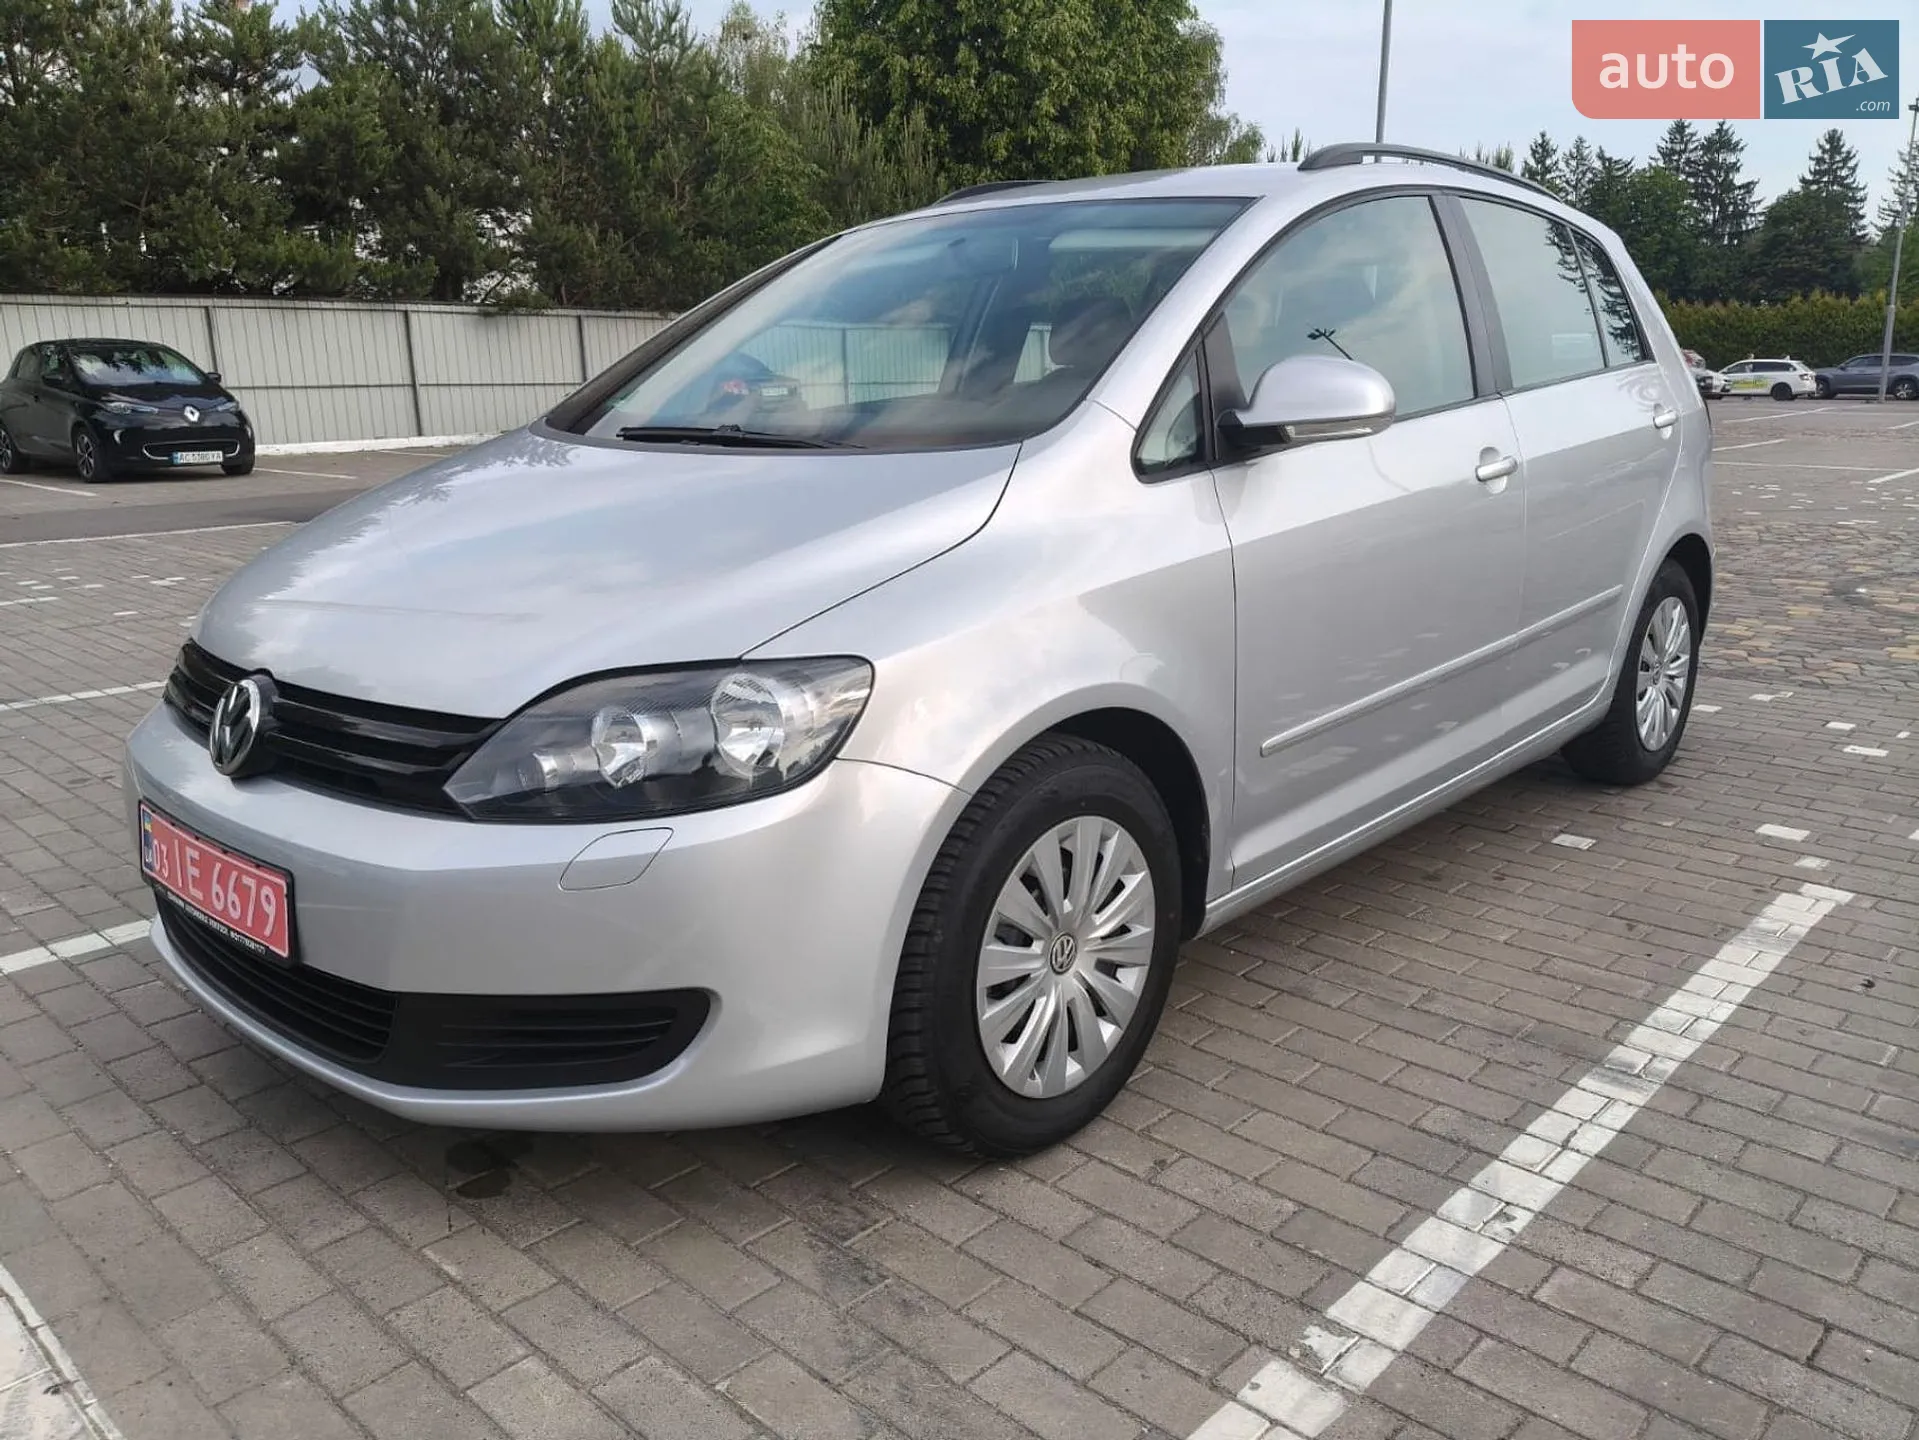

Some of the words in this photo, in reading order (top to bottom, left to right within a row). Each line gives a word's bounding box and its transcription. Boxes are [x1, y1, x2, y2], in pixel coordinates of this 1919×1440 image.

[152, 838, 169, 879] 03
[174, 839, 204, 901] IE
[211, 862, 276, 938] 6679
